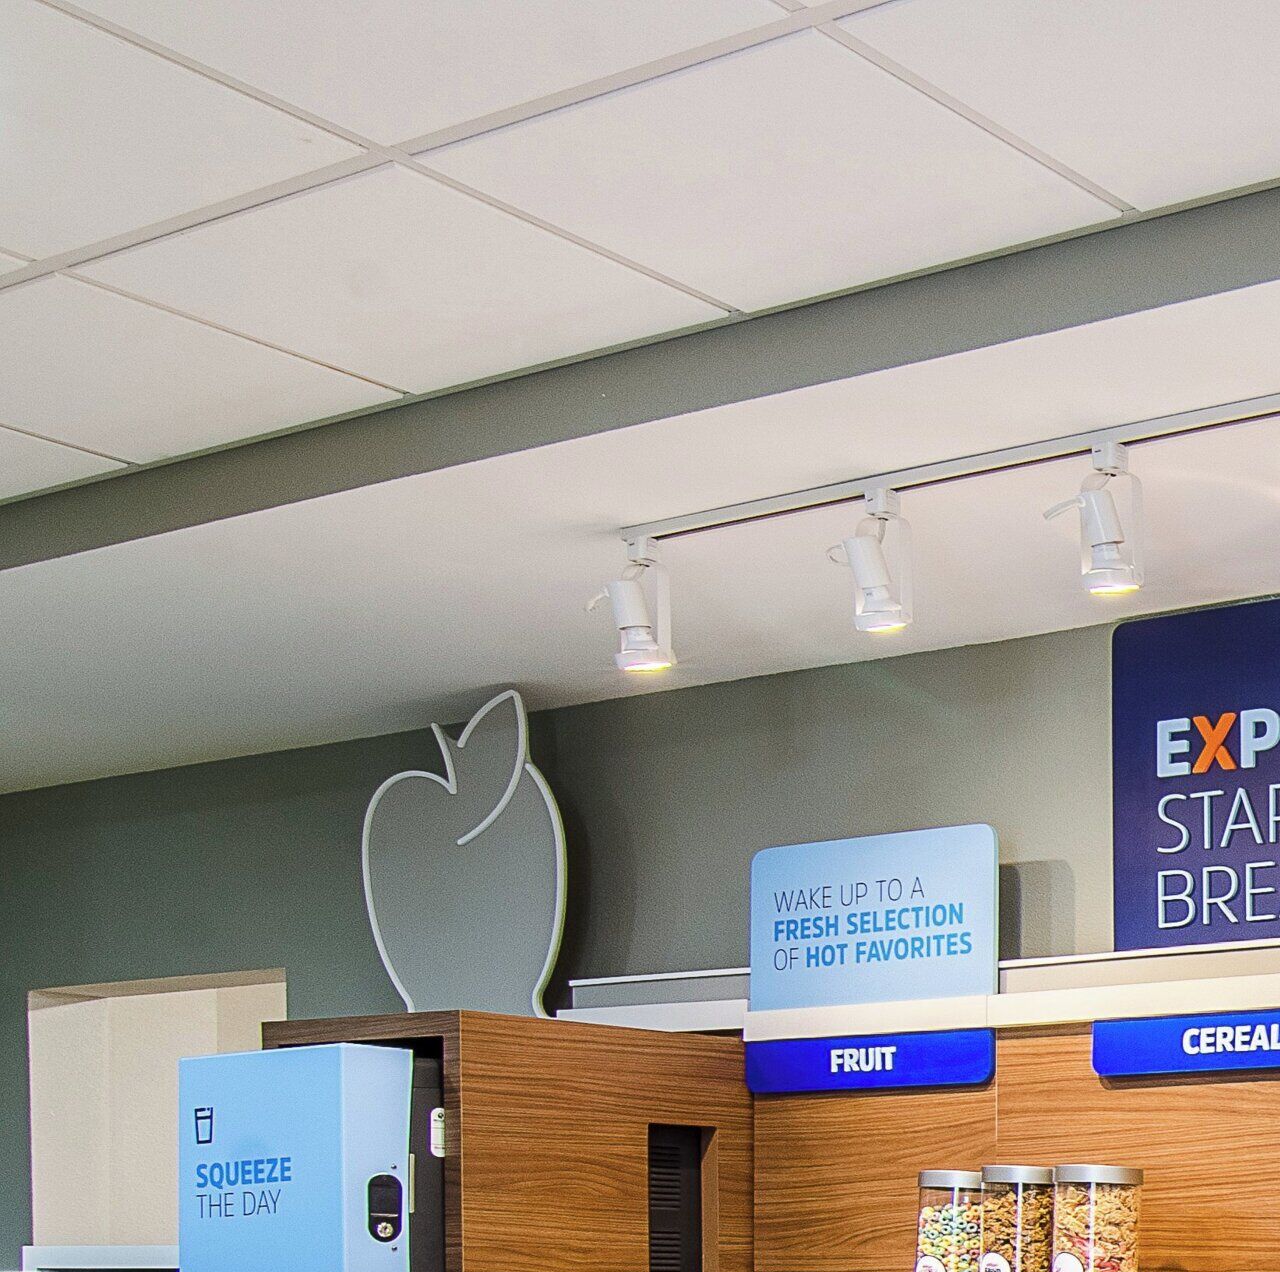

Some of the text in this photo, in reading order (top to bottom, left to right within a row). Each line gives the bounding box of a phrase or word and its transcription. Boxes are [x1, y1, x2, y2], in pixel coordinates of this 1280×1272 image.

[774, 876, 925, 913] WAKE UP TO A
[774, 902, 964, 942] FRESH SELECTION
[774, 931, 973, 971] OF HOT FAVORITES
[829, 1045, 897, 1074] FRUIT
[196, 1156, 292, 1189] SQUEEZE
[196, 1189, 281, 1218] THE DAY
